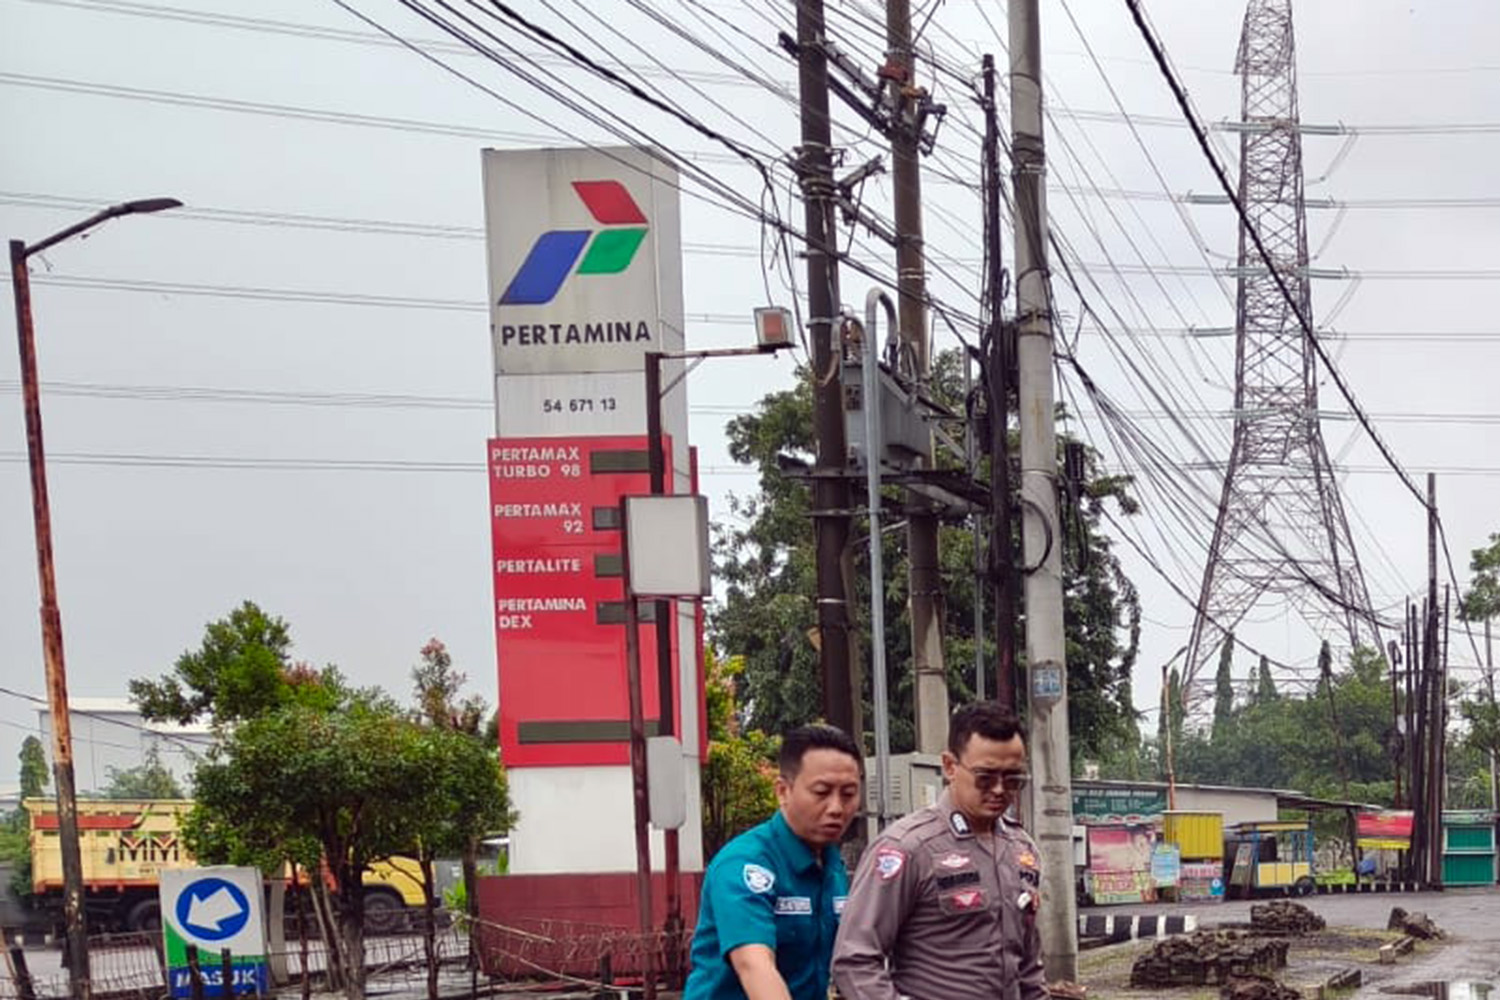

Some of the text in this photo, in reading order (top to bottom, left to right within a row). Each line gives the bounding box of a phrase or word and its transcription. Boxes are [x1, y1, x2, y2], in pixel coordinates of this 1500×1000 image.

[501, 321, 651, 345] PERTAMINA
[543, 398, 616, 412] 54 671 13
[491, 447, 580, 461] PERTAMAX
[494, 464, 581, 478] TURBO 98
[494, 503, 582, 517] PERTAMAX
[563, 520, 584, 533] 92
[497, 558, 581, 573] PERTALITE
[498, 598, 586, 612] PERTAMINA
[499, 615, 532, 629] DEX
